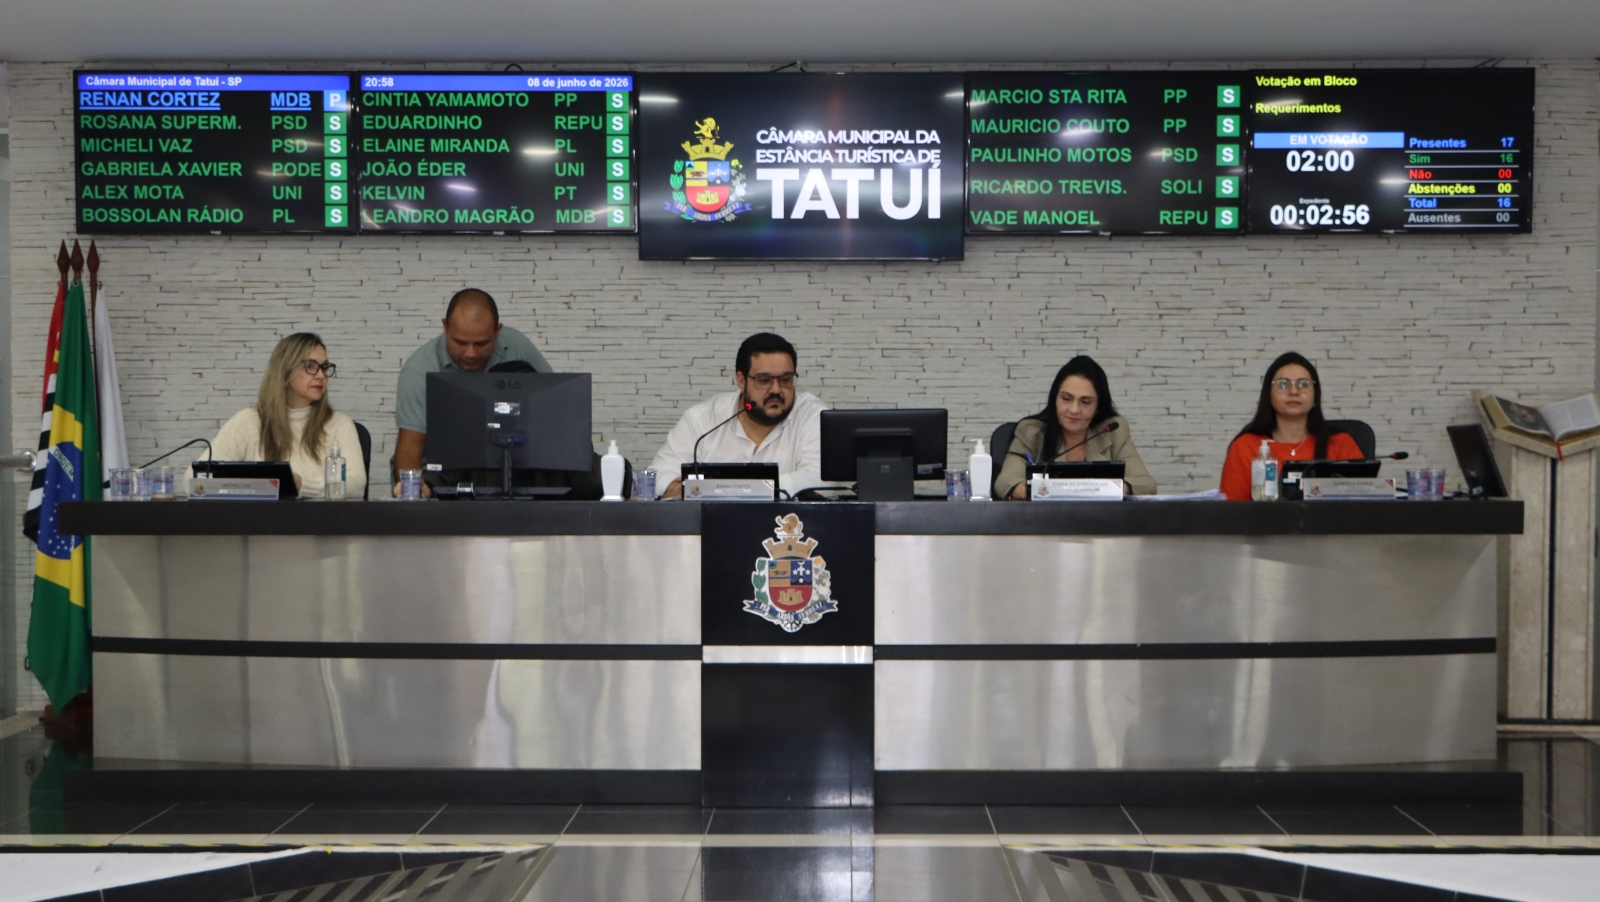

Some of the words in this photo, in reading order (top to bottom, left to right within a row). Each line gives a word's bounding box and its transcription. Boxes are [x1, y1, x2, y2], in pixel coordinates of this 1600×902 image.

[86, 77, 124, 85] Câmara
[128, 77, 176, 87] Municipal
[179, 77, 191, 85] de
[228, 77, 242, 86] SP
[365, 78, 394, 87] 20:58
[528, 78, 539, 87] 08
[543, 78, 555, 87] de
[557, 78, 586, 89] junho
[589, 78, 602, 87] de
[604, 78, 628, 87] 2026
[1256, 76, 1300, 87] Votação
[1324, 76, 1357, 86] Bloco
[80, 92, 142, 106] RENAN
[148, 92, 220, 107] CORTEZ
[271, 93, 311, 106] MDB
[330, 94, 341, 106] P
[363, 92, 421, 107] CINTIA
[425, 92, 529, 107] YAMAMOTO
[554, 93, 577, 107] PP
[612, 94, 623, 108] S
[971, 90, 1043, 104] MARCIO
[1048, 90, 1082, 104] STA
[1088, 90, 1127, 103] RITA
[1164, 90, 1187, 103] PP
[1223, 89, 1235, 104] S
[1256, 103, 1341, 115] Requerimentos
[81, 115, 156, 129] ROSANA
[162, 115, 242, 129] SUPERM.
[272, 116, 307, 129] PSD
[330, 116, 341, 130] S
[363, 115, 482, 129] EDUARDINHO
[555, 116, 602, 129] REPU
[612, 116, 623, 131] S
[971, 119, 1060, 133] MAURICIO
[1066, 119, 1130, 133] COUTO
[1163, 119, 1187, 133] PP
[1222, 118, 1234, 133] S
[756, 126, 825, 144] CÂMARA
[828, 130, 915, 144] MUNICIPAL
[916, 130, 940, 144] DA
[1290, 136, 1308, 145] EM
[1310, 134, 1368, 146] VOTAÇÃO
[81, 139, 153, 152] MICHELI
[159, 139, 193, 152] VAZ
[272, 139, 307, 153] PSD
[330, 138, 341, 153] S
[363, 139, 425, 153] ELAINE
[431, 138, 510, 153] MIRANDA
[555, 139, 577, 153] PL
[612, 139, 623, 154] S
[1409, 138, 1466, 148] Presentes
[1501, 138, 1514, 147] 17
[756, 146, 833, 163] ESTÂNCIA
[835, 146, 916, 163] TURÍSTICA
[919, 149, 941, 163] DE
[971, 148, 1061, 162] PAULINHO
[1067, 148, 1131, 162] MOTOS
[1162, 148, 1197, 162] PSD
[1222, 147, 1234, 162] S
[1286, 150, 1354, 172] 02:00
[1409, 154, 1430, 163] Sim
[1501, 154, 1513, 163] 16
[81, 162, 173, 176] GABRIELA
[178, 162, 242, 176] XAVIER
[272, 162, 322, 176] PODE
[330, 162, 341, 177] S
[362, 159, 411, 177] JOÃO
[418, 159, 466, 176] ÉDER
[555, 162, 584, 176] UNI
[612, 162, 623, 177] S
[1409, 170, 1432, 179] Não
[1498, 169, 1512, 179] 00
[82, 186, 128, 199] ALEX
[134, 185, 184, 199] MOTA
[273, 186, 302, 199] UNI
[330, 185, 341, 200] S
[363, 186, 425, 200] KELVIN
[555, 186, 577, 200] PT
[613, 186, 624, 200] S
[756, 163, 941, 219] TATUÍ
[971, 180, 1053, 194] RICARDO
[1059, 180, 1127, 194] TREVIS.
[1161, 180, 1202, 194] SOLI
[1221, 180, 1233, 194] S
[1408, 184, 1475, 195] Abstenções
[1498, 184, 1511, 194] 00
[1409, 198, 1436, 208] Total
[1498, 198, 1510, 208] 16
[83, 208, 182, 223] BOSSOLAN
[187, 205, 244, 223] RÁDIO
[273, 209, 294, 222] PL
[330, 208, 342, 223] S
[363, 209, 449, 223] LEANDRO
[454, 206, 534, 223] MAGRÃO
[556, 210, 596, 223] MDB
[613, 209, 624, 223] S
[971, 211, 1017, 224] VADE
[1024, 210, 1100, 225] MANOEL
[1160, 211, 1208, 224] REPU
[1221, 210, 1232, 225] S
[1270, 205, 1370, 225] 00:02:56
[1408, 213, 1461, 223] Ausentes
[1496, 213, 1509, 222] 00
